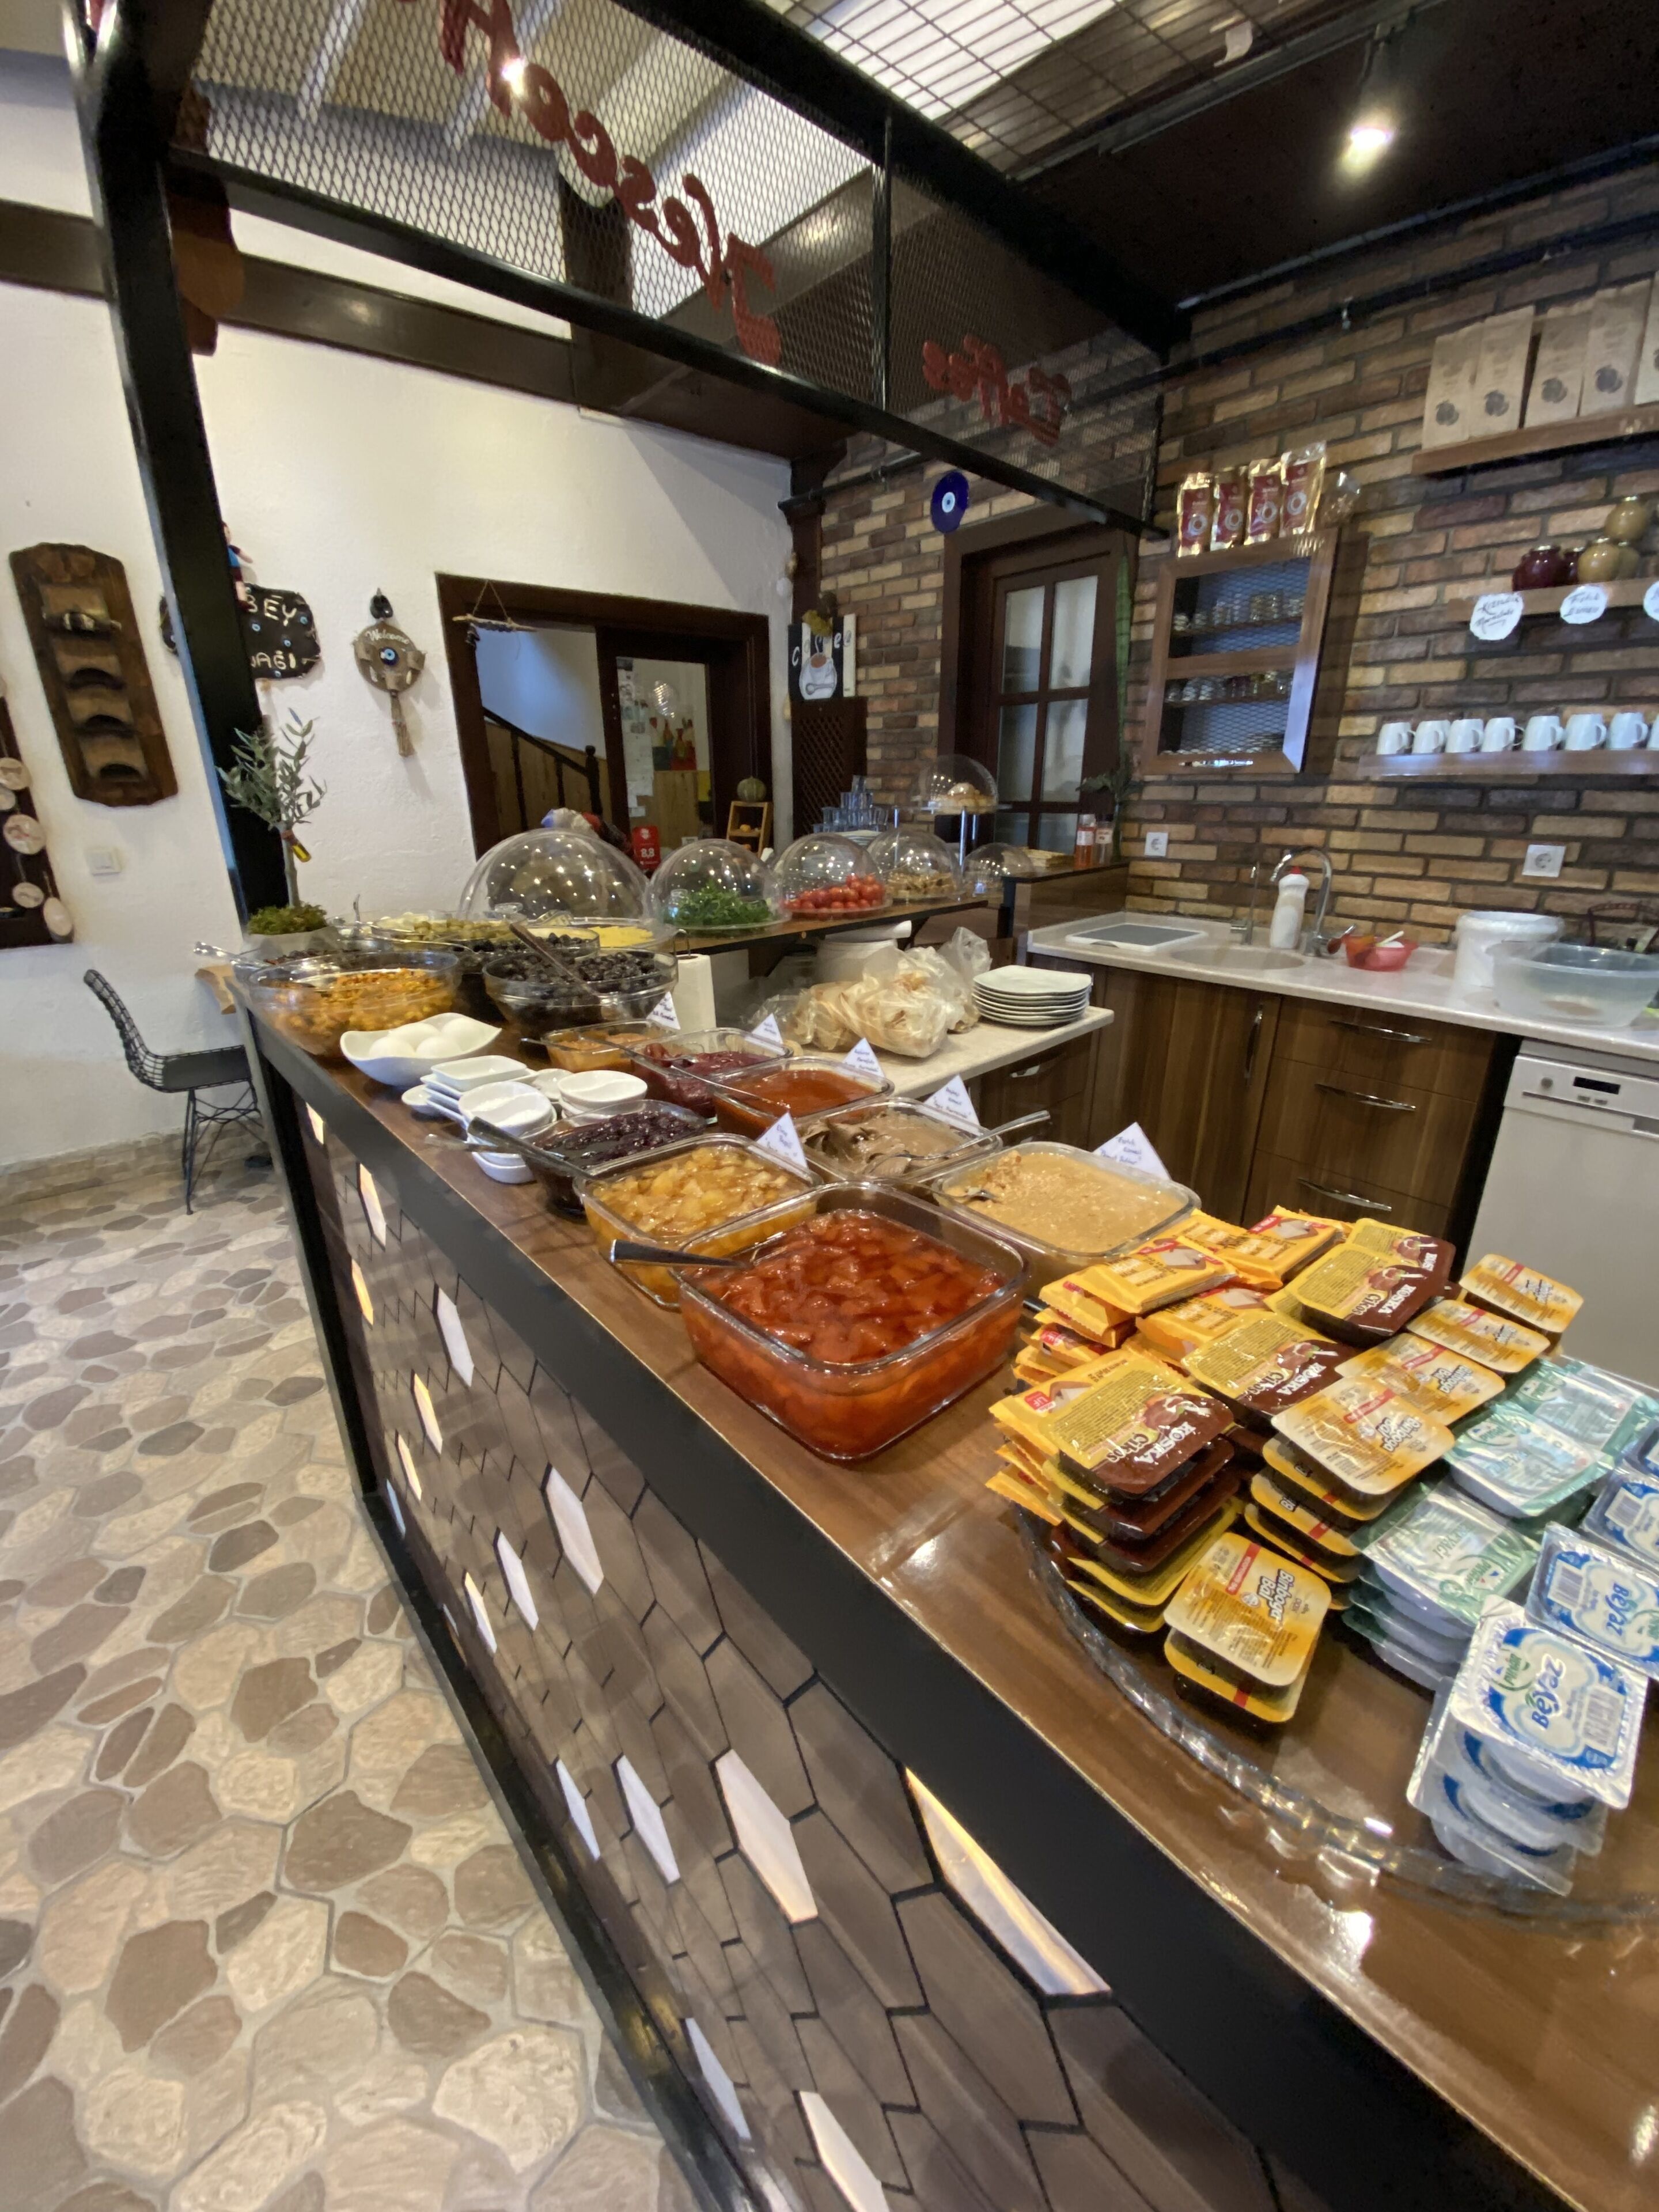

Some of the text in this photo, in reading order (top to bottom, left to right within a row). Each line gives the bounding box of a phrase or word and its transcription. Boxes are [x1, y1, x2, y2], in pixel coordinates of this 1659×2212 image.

[365, 628, 410, 645] Welcome
[1377, 1283, 1416, 1315] KOSKA
[1276, 1362, 1327, 1396] KOSKA
[1134, 1421, 1196, 1464] KOSKA
